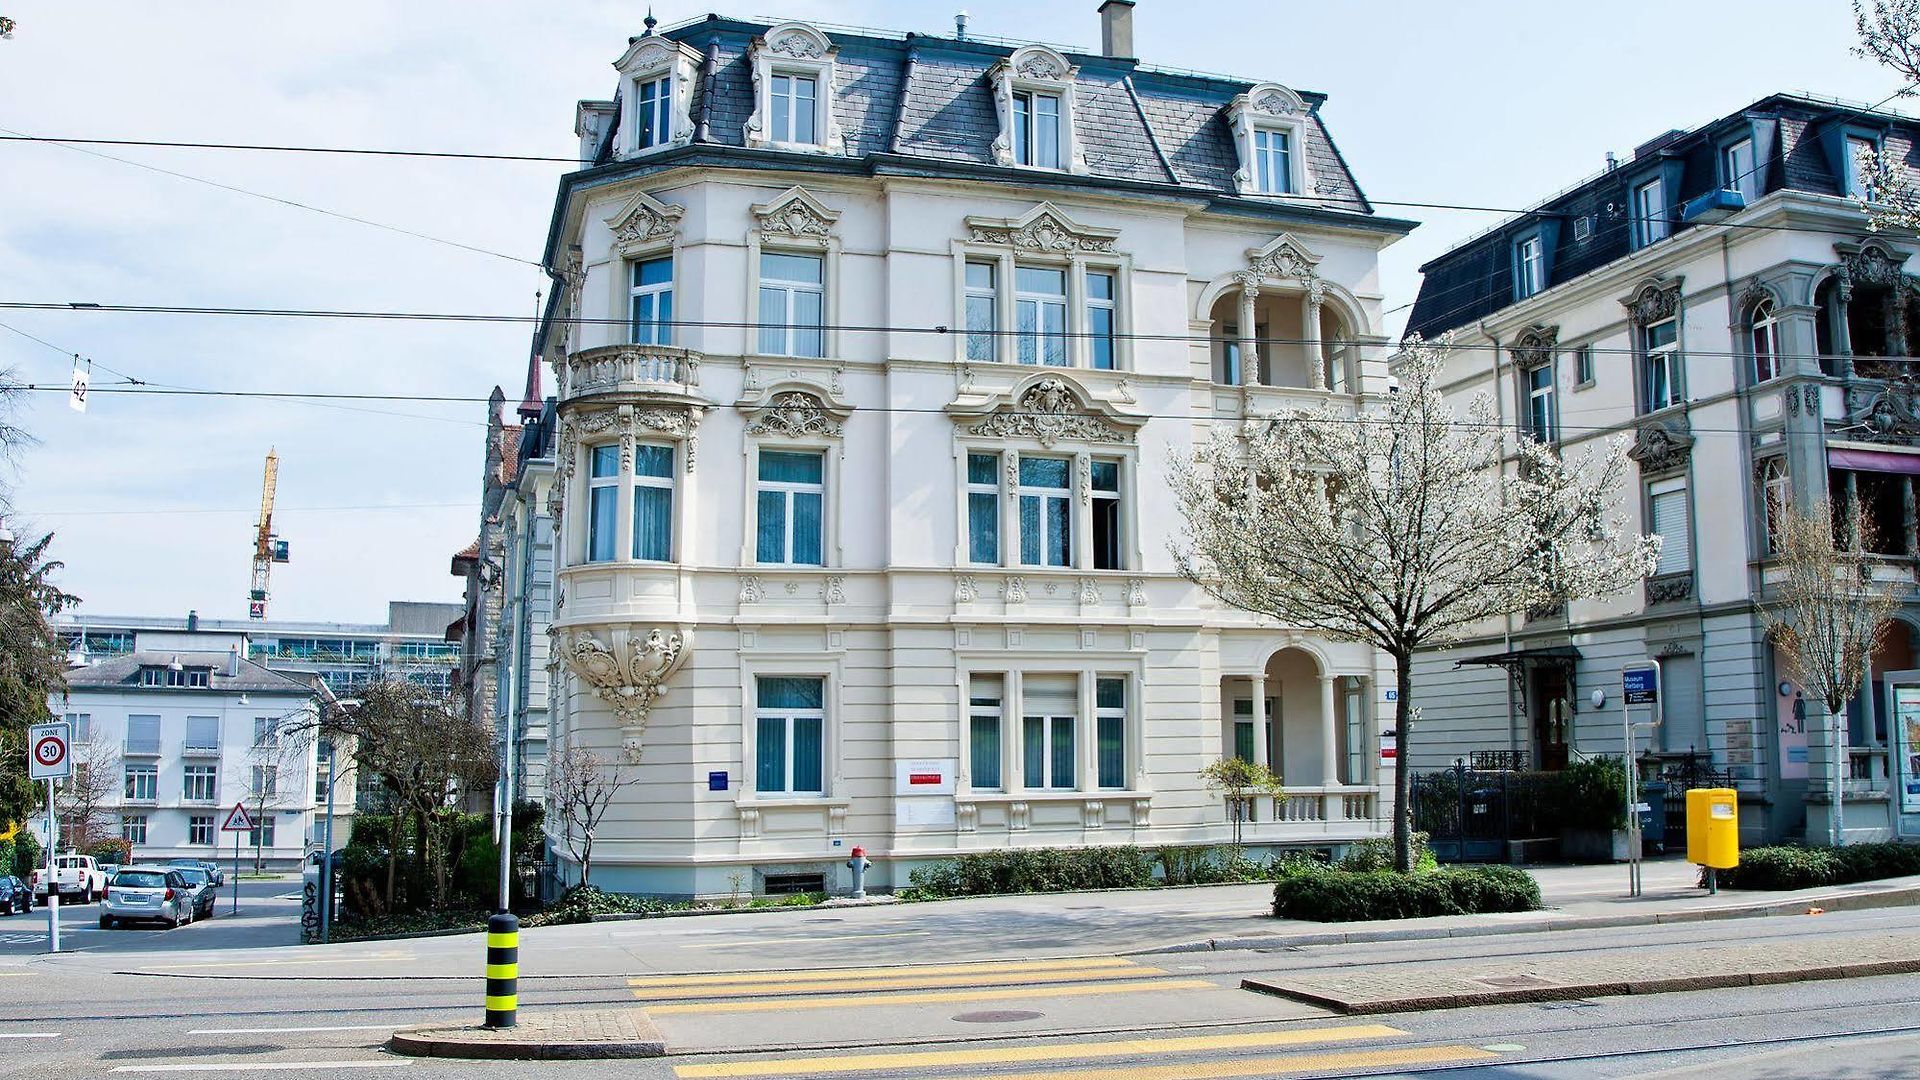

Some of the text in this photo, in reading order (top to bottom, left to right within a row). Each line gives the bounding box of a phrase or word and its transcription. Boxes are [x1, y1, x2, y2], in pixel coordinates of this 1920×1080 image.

[73, 380, 87, 402] 42
[1628, 694, 1634, 703] 7
[41, 729, 59, 737] ZONE
[43, 745, 57, 758] 30
